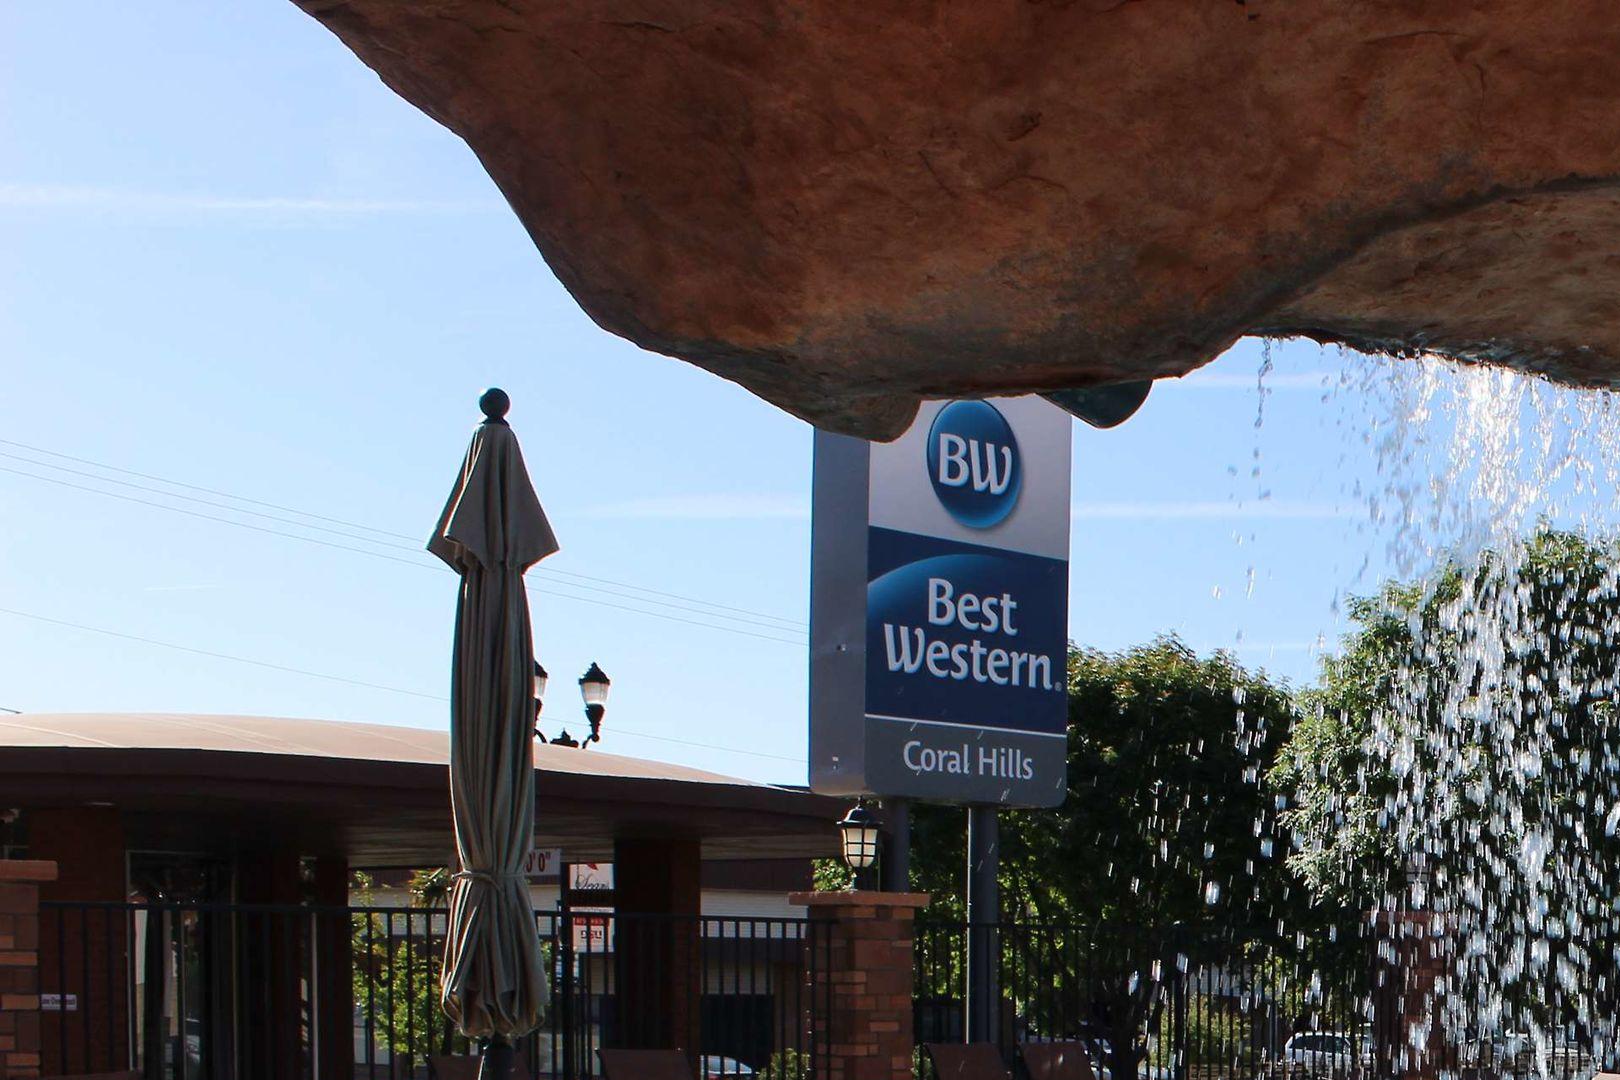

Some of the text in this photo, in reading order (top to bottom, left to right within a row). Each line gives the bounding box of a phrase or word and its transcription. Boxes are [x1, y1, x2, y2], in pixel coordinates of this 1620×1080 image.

[939, 433, 1012, 495] BW
[928, 578, 1018, 637] Best
[884, 623, 1054, 691] Western
[903, 741, 1034, 780] Coral Hills
